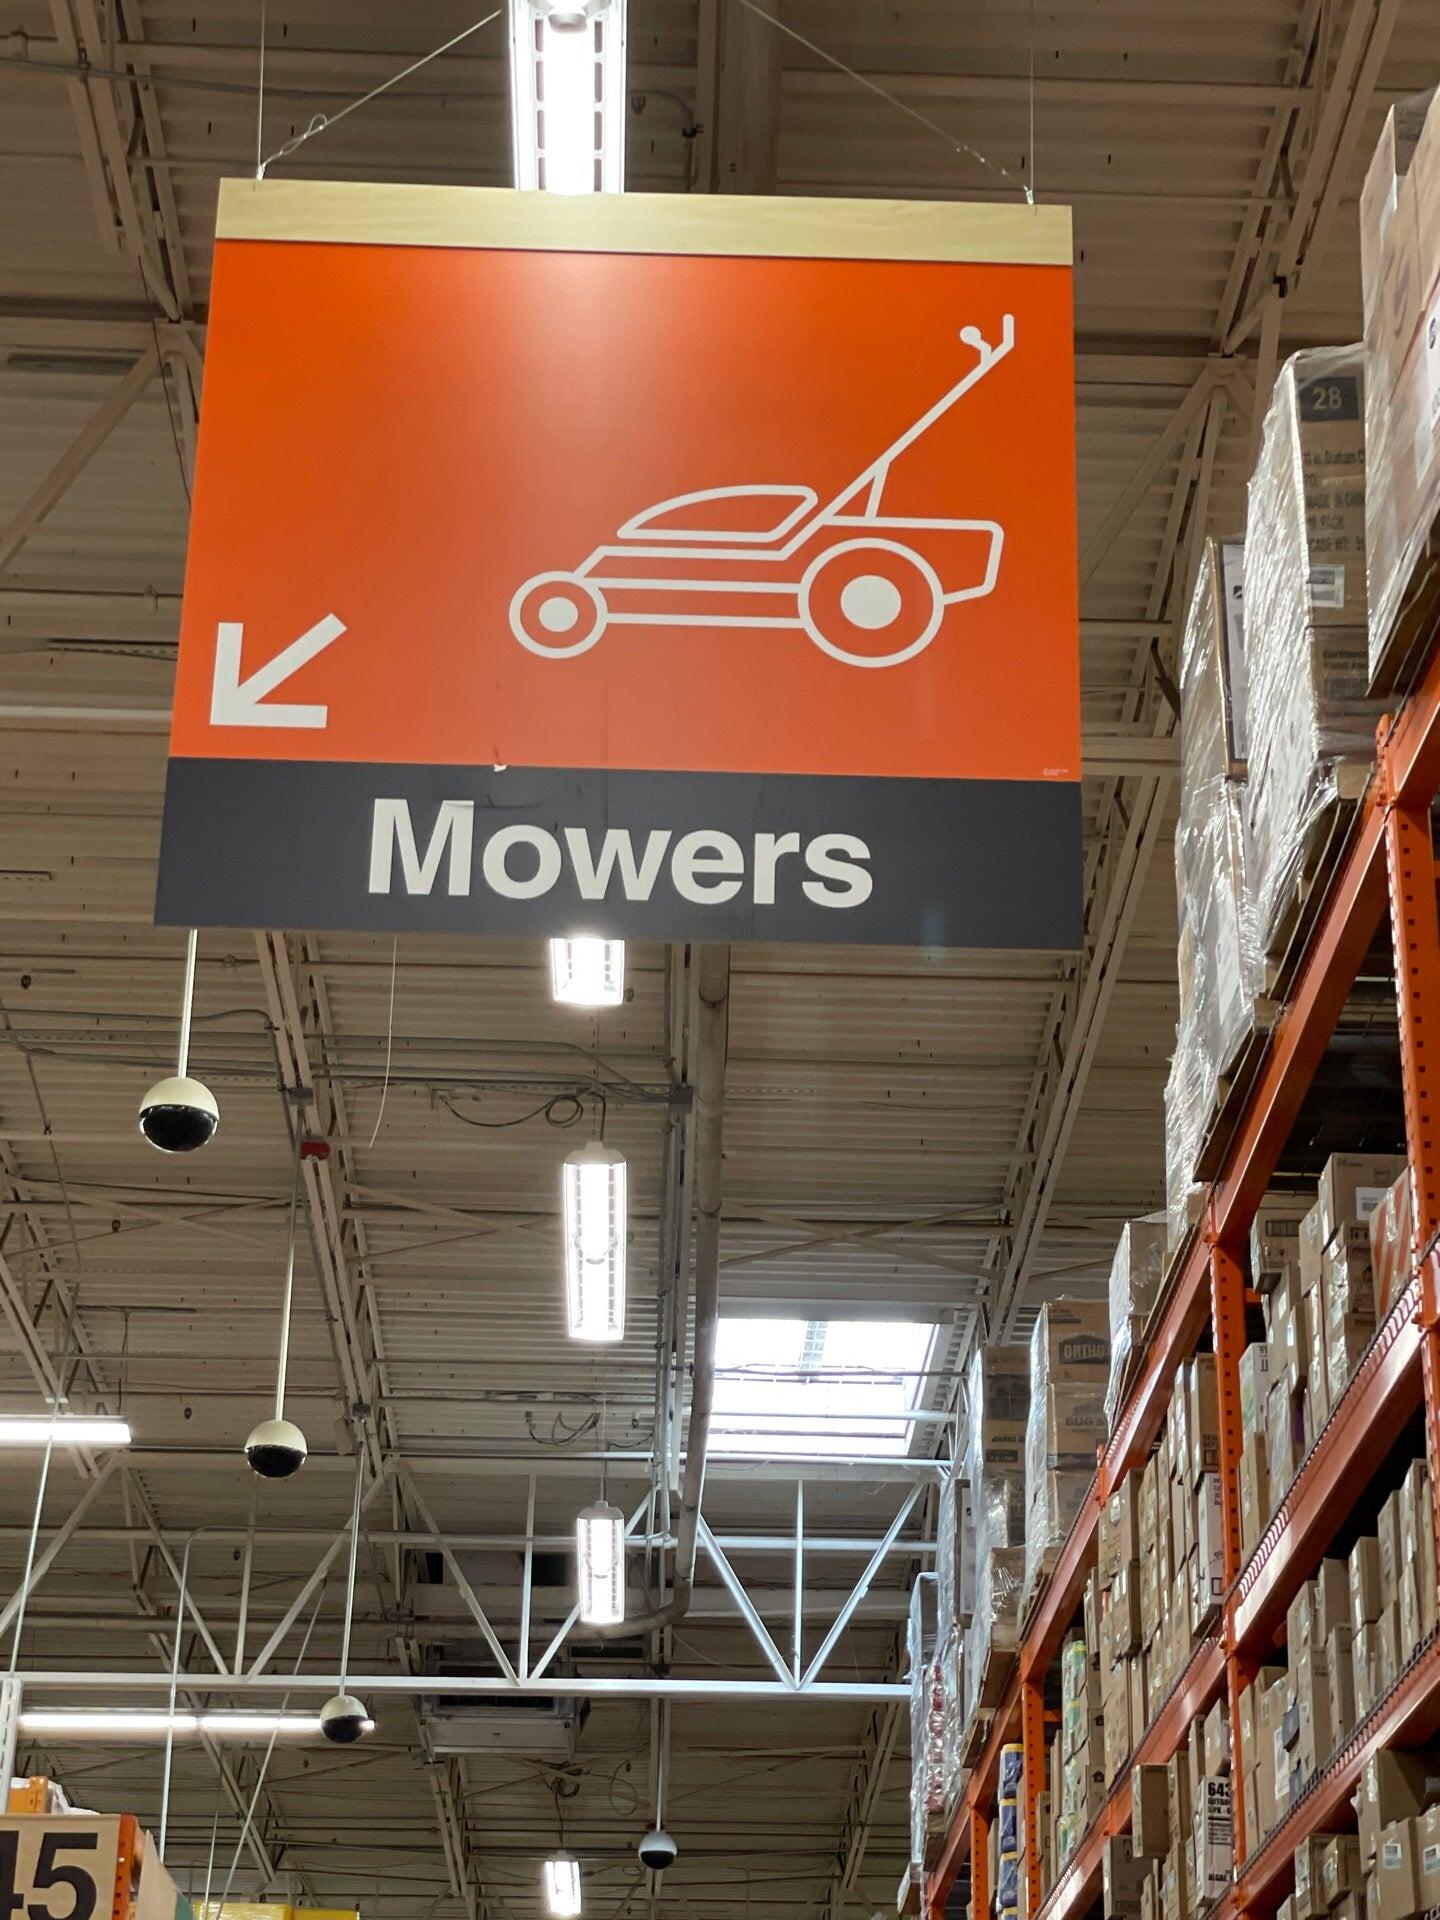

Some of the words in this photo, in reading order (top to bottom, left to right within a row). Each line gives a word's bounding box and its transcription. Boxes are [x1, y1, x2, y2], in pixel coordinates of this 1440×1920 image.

[1313, 386, 1342, 411] 28
[368, 798, 873, 908] Mowers
[1063, 1343, 1105, 1360] ORTHO
